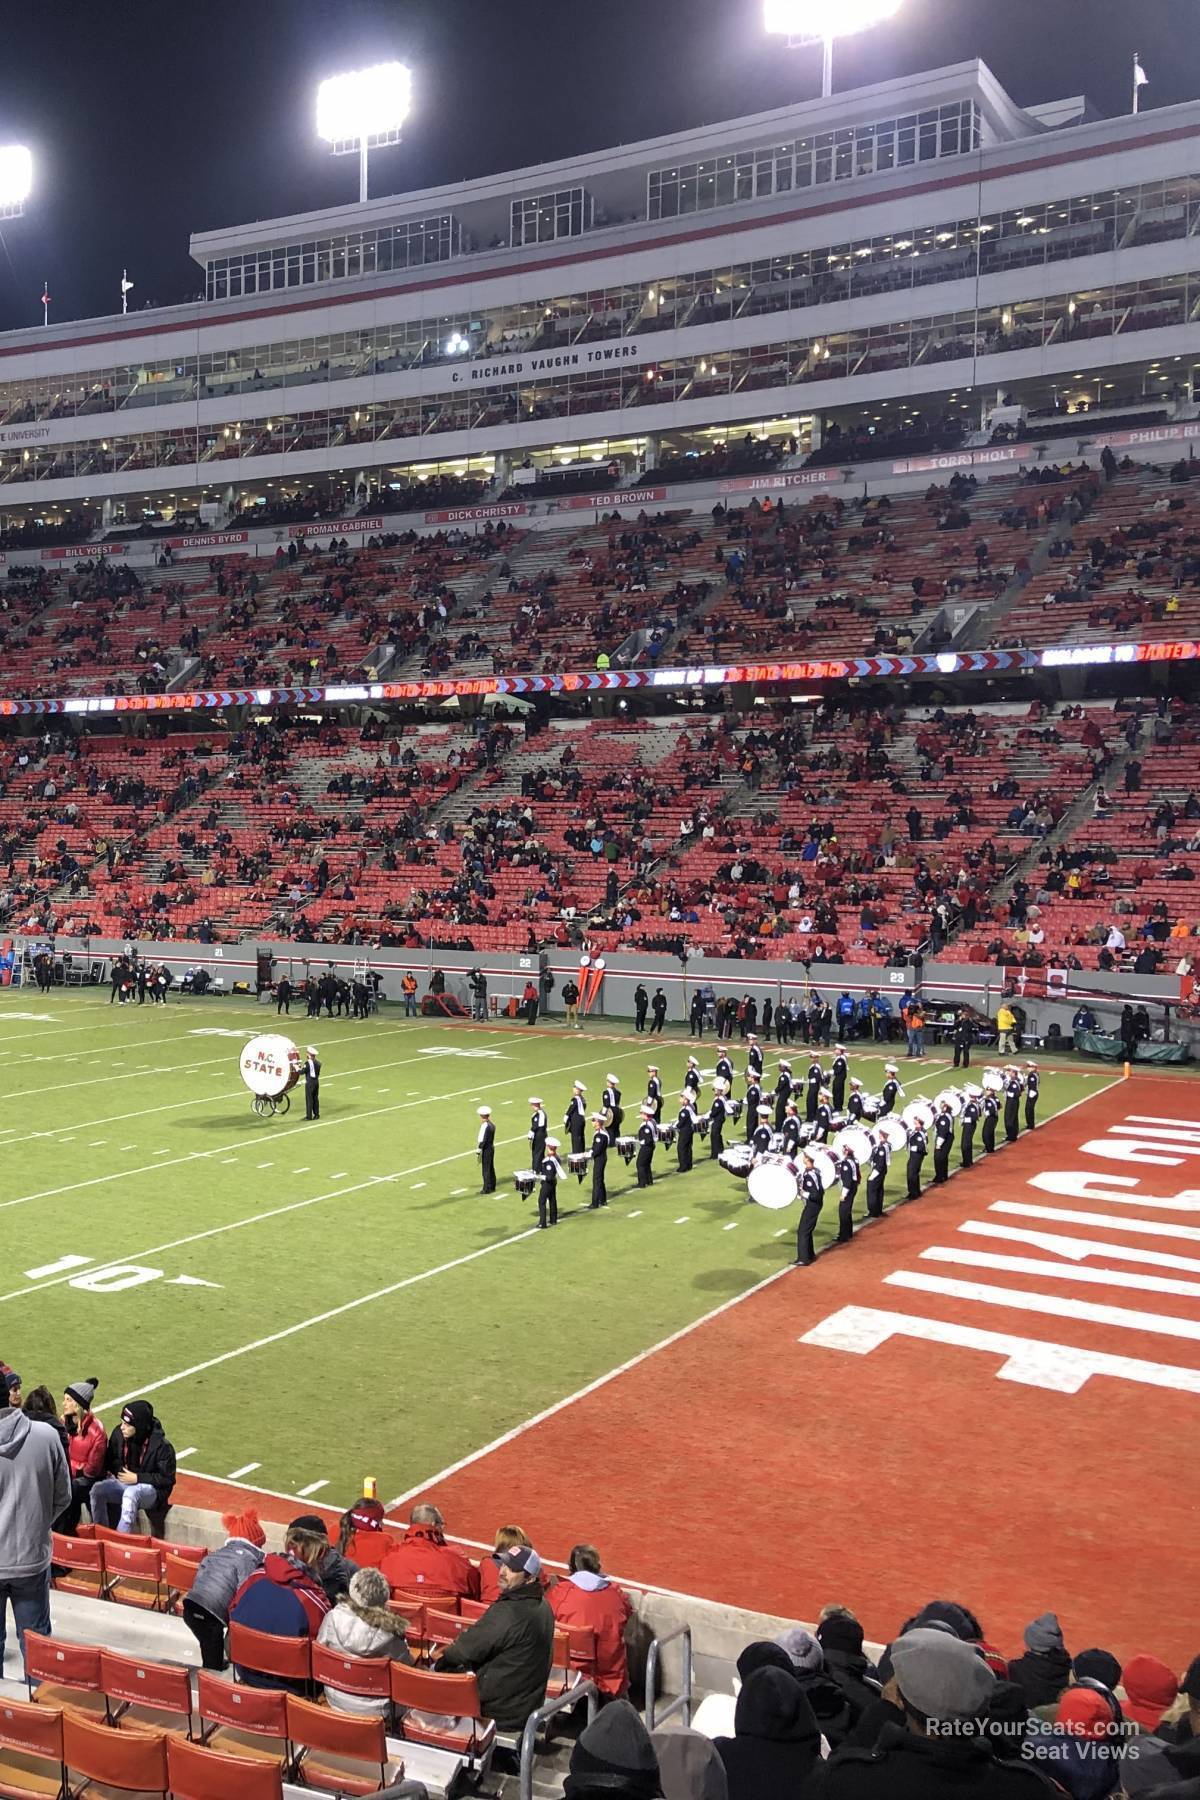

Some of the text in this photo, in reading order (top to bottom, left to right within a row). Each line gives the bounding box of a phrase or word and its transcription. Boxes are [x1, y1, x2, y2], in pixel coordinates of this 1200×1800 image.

[452, 345, 638, 382] C. RICHARD VAUGHN TOWERS
[8, 428, 50, 440] UNIVERSITY
[1129, 428, 1178, 442] PHILIP
[980, 449, 1016, 462] HOLT
[748, 472, 826, 489] JIM RITCHER
[590, 491, 655, 506] TED BROWN
[448, 505, 520, 521] DICK CHRISTY
[307, 519, 381, 536] ROMAN GABRIEL
[183, 533, 242, 547] DENNIS BYRD
[65, 545, 113, 557] BILL YOEST
[214, 948, 223, 957] 21
[520, 958, 531, 968] 22
[890, 972, 905, 983] 23
[244, 1059, 282, 1077] STATE
[23, 1254, 165, 1292] 10
